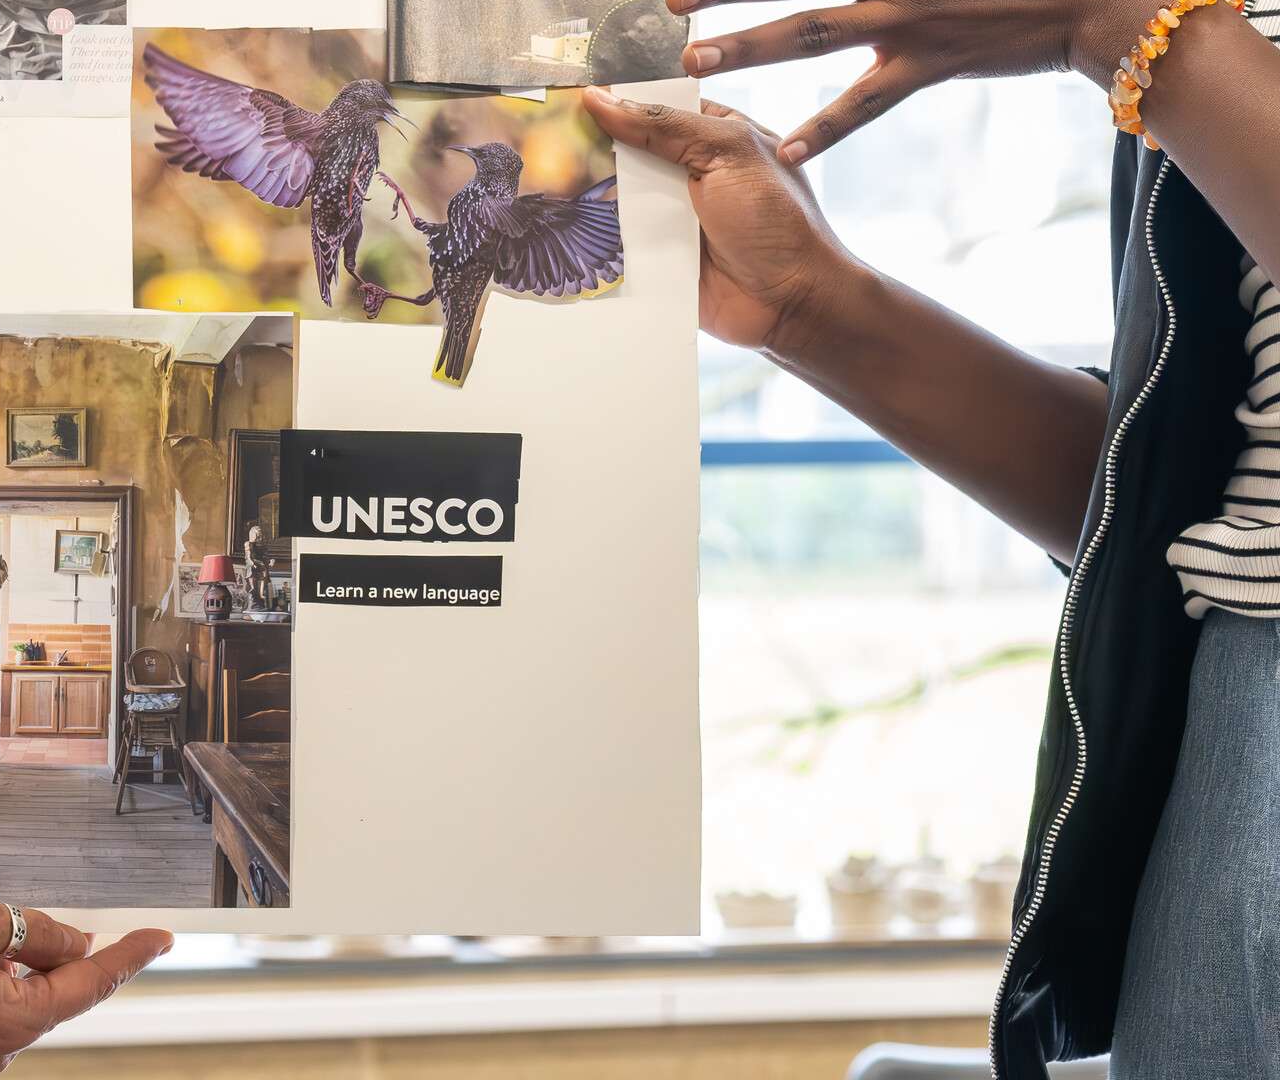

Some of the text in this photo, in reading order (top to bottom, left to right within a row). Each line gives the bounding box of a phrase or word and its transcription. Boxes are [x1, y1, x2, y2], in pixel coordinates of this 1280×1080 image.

[312, 495, 504, 536] UNESCO
[316, 581, 501, 605] Learn a new language
